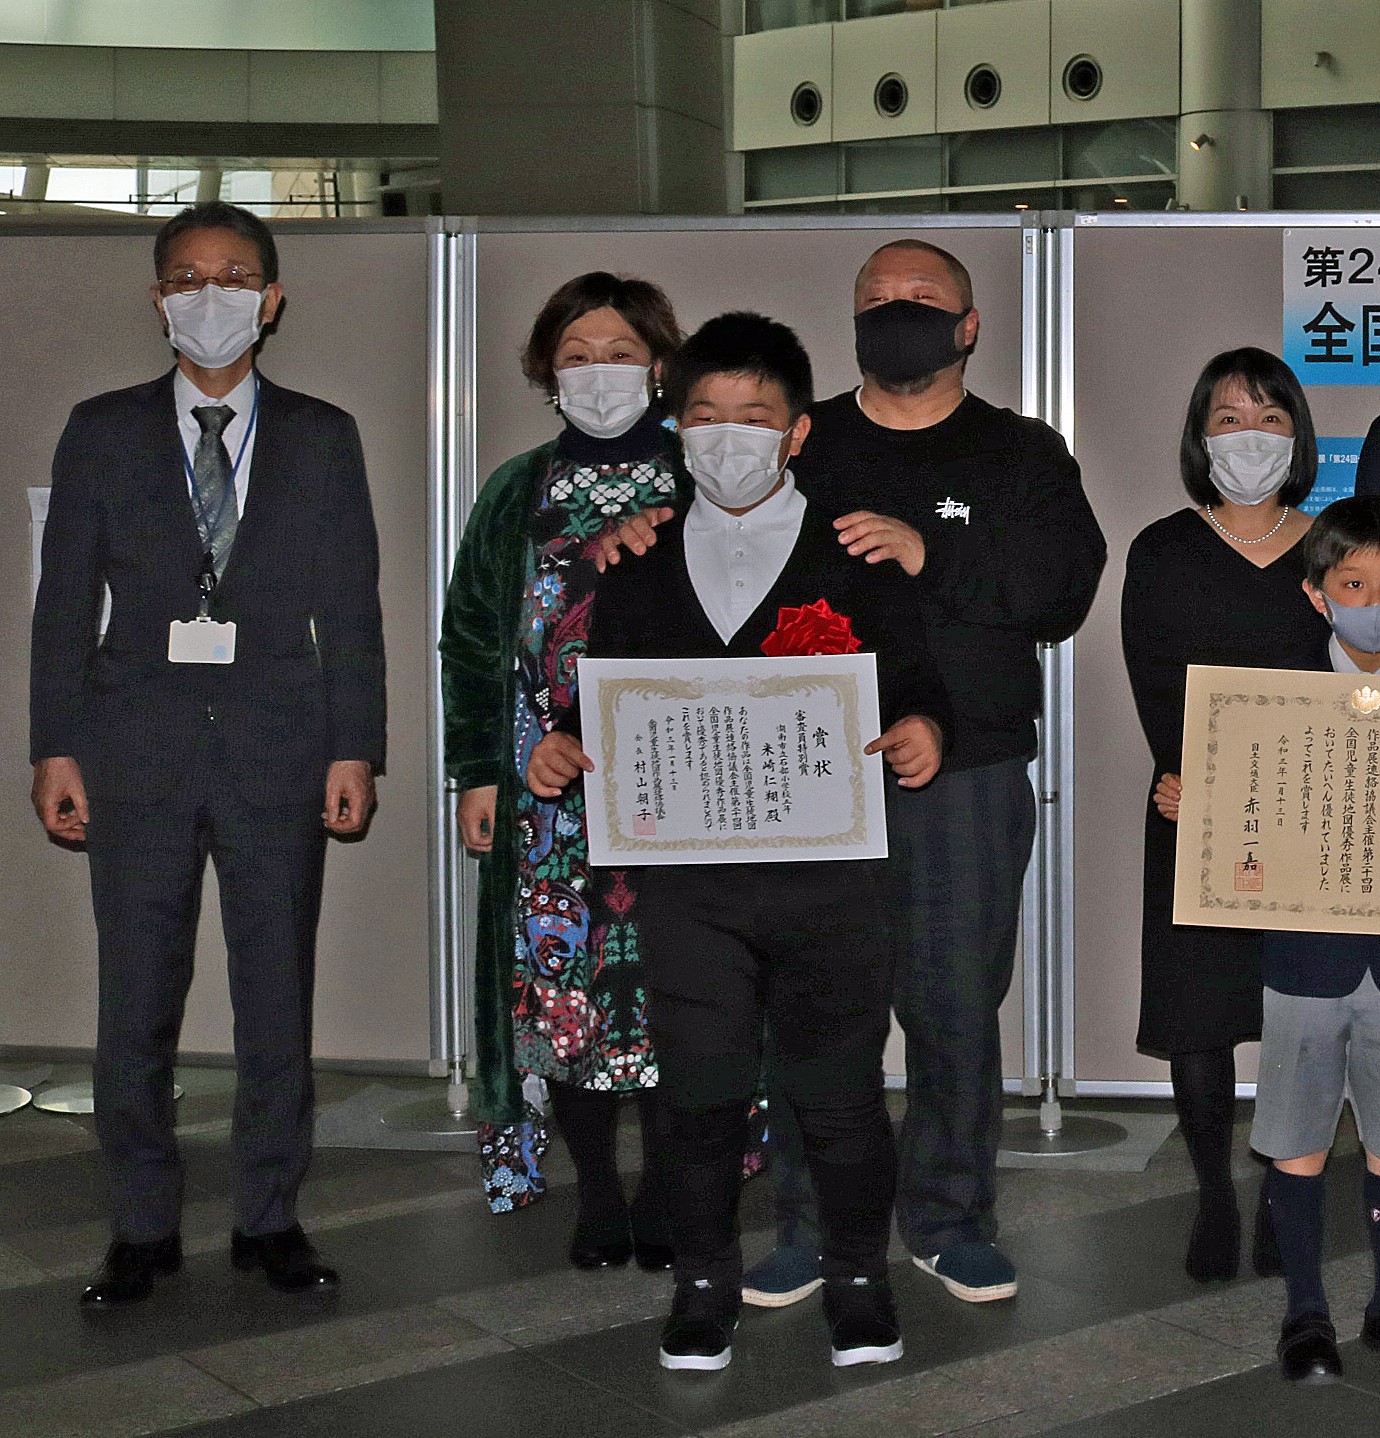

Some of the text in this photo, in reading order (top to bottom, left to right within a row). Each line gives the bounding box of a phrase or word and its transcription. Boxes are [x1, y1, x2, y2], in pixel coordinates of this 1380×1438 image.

[812, 726, 833, 778] 賞状
[1275, 734, 1289, 827] 令和三年一月十三日
[1299, 725, 1315, 835] よってこれを賞します
[1318, 726, 1336, 891] おいてたいへん優れていました
[1339, 727, 1360, 893] 全国児童生徒地図優秀作品展に
[1361, 728, 1380, 894] 作品展連絡協議会主催第二十四回
